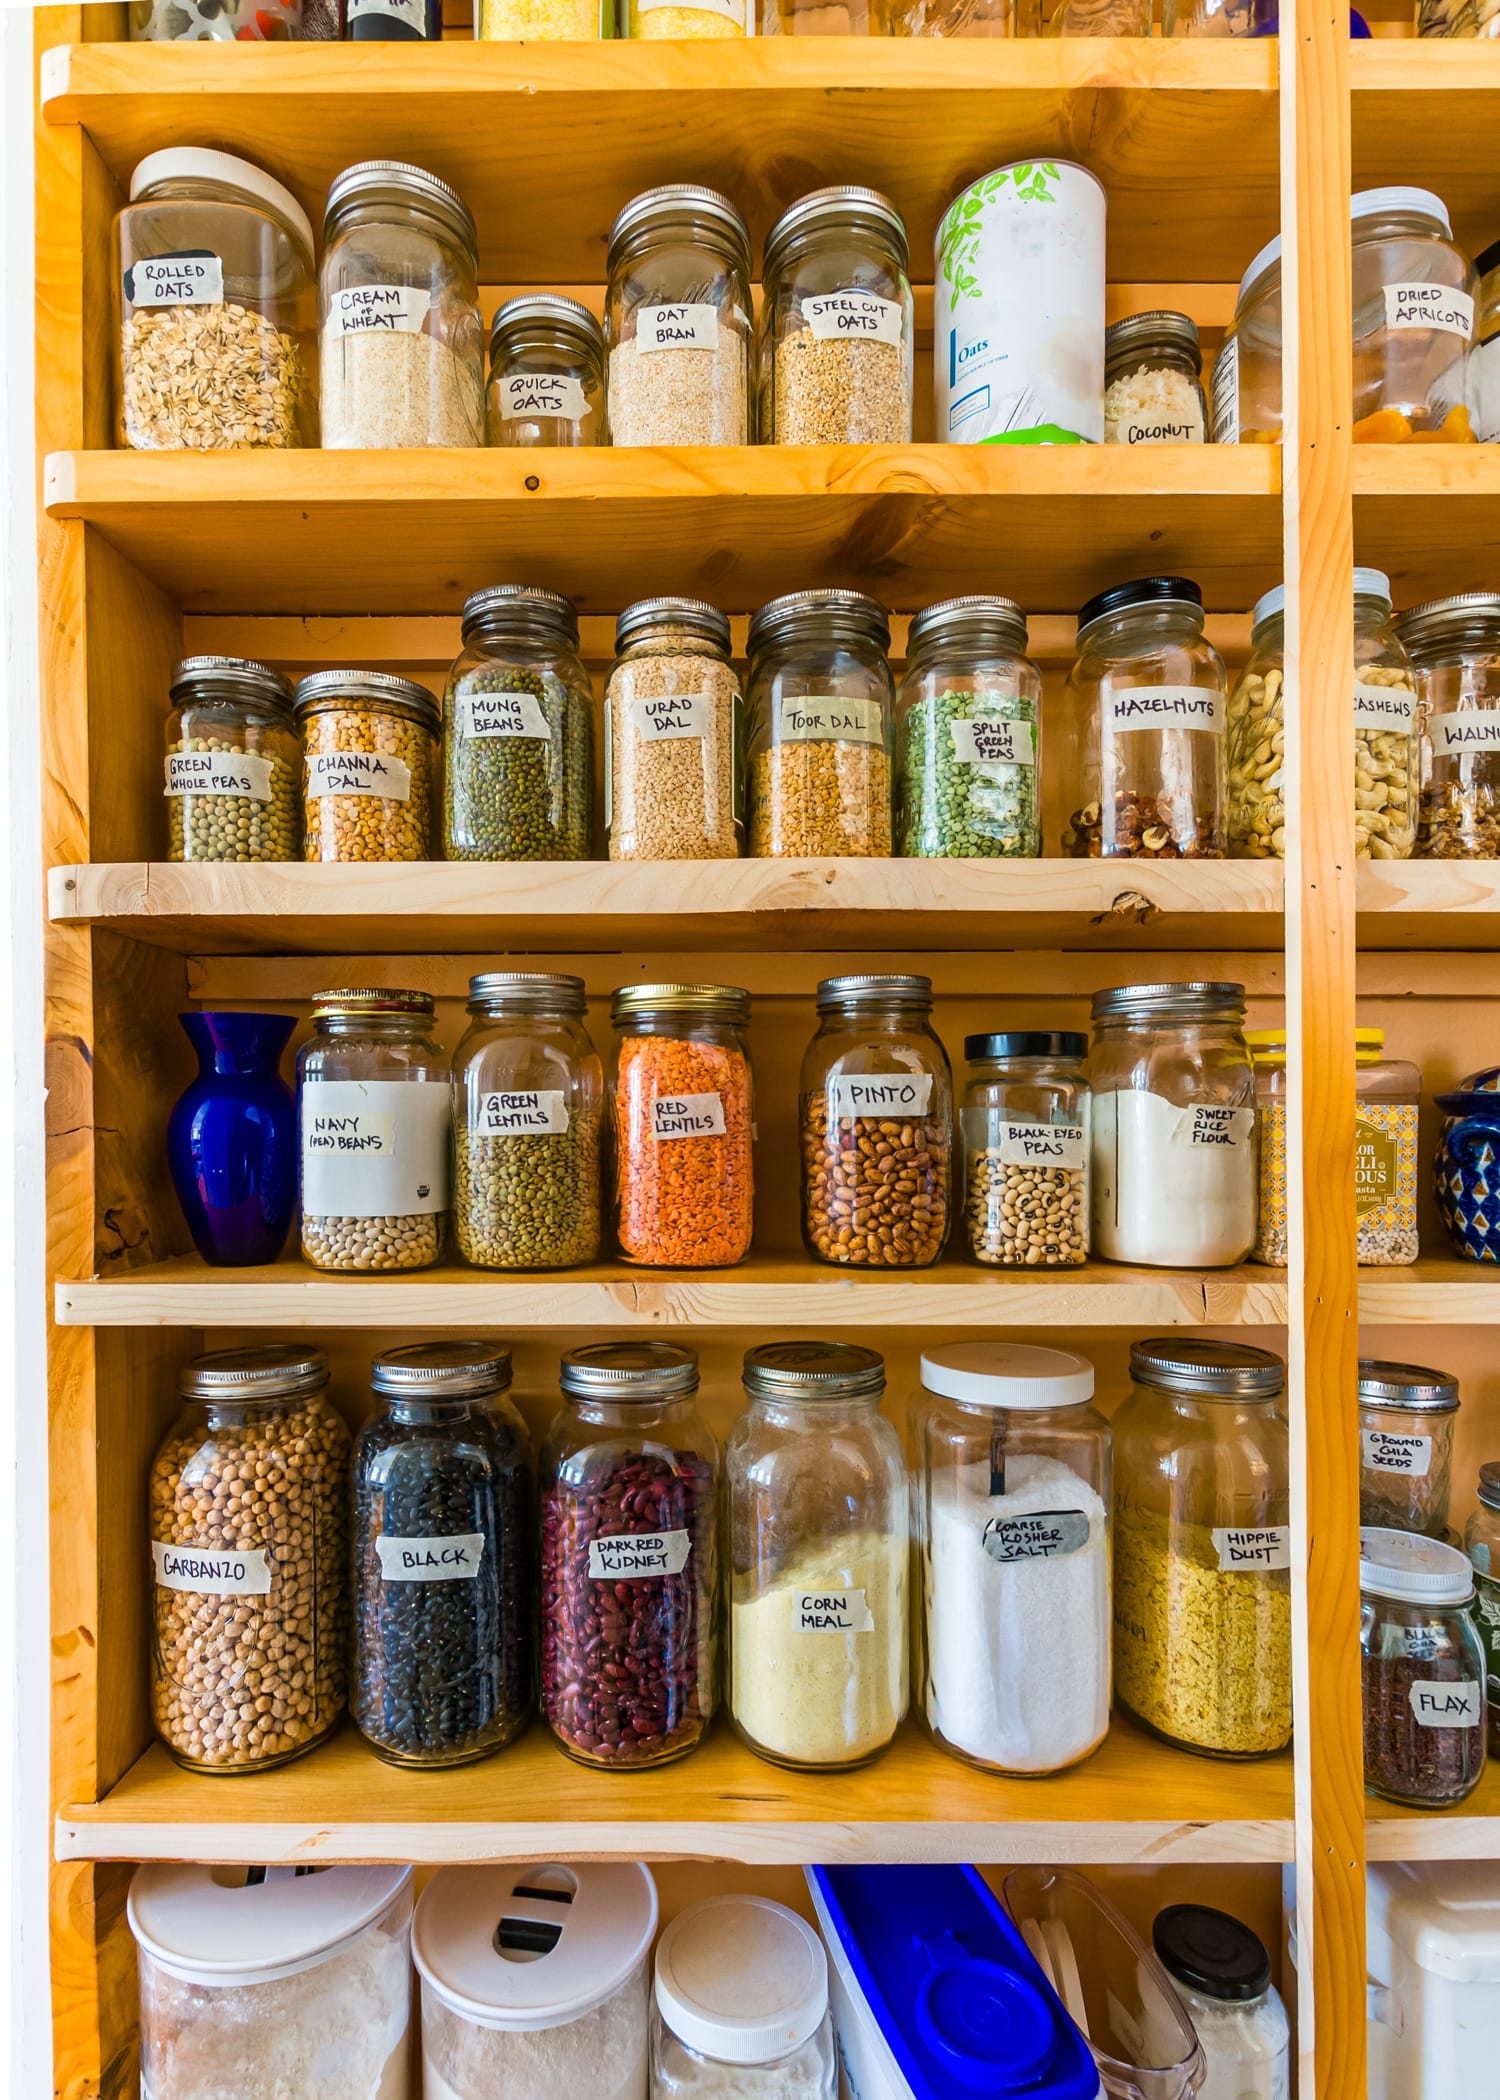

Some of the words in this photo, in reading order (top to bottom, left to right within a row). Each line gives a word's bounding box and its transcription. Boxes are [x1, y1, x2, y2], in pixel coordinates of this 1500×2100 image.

[146, 265, 204, 280] ROLLED
[156, 282, 193, 298] OATS
[1398, 290, 1441, 302] DRIED
[339, 288, 400, 311] CREAM
[657, 309, 688, 322] OAT
[813, 300, 857, 317] STEEL
[860, 303, 887, 320] CUT
[343, 312, 408, 330] WHEAT
[838, 315, 877, 329] OATS
[1396, 307, 1468, 332] APRICOTS
[657, 328, 695, 342] BRAN
[958, 339, 989, 363] Oats
[510, 378, 567, 392] QUICK
[513, 394, 562, 410] OATS
[1129, 424, 1194, 443] COCONUT
[472, 700, 520, 714] MUNG
[646, 699, 692, 715] URAD
[1115, 698, 1214, 717] HAZELNUTS
[474, 718, 524, 732] BEANS
[654, 716, 691, 731] DAL
[787, 711, 826, 730] TOOR
[831, 715, 866, 729] DAL
[972, 723, 1010, 736] SPLIT
[974, 735, 1012, 749] GREEN
[979, 747, 1014, 759] PEAS
[170, 757, 211, 775] GREEN
[318, 757, 388, 775] CHANNA
[170, 779, 208, 790] WHOLE
[212, 776, 251, 790] PEAS
[328, 775, 371, 788] DAL
[851, 1085, 915, 1104] PINTO
[487, 1094, 538, 1112] GREEN
[656, 1102, 688, 1117] RED
[488, 1110, 549, 1127] LENTILS
[1197, 1109, 1236, 1120] SWEET
[316, 1117, 359, 1132] NAVY
[656, 1115, 714, 1132] LENTILS
[1195, 1121, 1227, 1131] RICE
[310, 1135, 334, 1148] (PEA)
[338, 1136, 382, 1150] BEANS
[1193, 1129, 1236, 1145] FLOUR
[1024, 1142, 1063, 1155] PEAS
[1356, 1145, 1375, 1155] OR
[1355, 1170, 1387, 1183] OUS
[1370, 1434, 1423, 1448] GROUND
[1379, 1444, 1413, 1456] CHIA
[1372, 1453, 1412, 1467] SEEDS
[996, 1521, 1046, 1533] COARSE
[1000, 1528, 1063, 1546] KOSHER
[1228, 1533, 1280, 1545] HIPPIE
[598, 1541, 635, 1553] DARK
[634, 1539, 663, 1551] RED
[1001, 1544, 1056, 1558] SALT
[403, 1549, 469, 1567] BLACK
[600, 1550, 668, 1570] KIDNEY
[1229, 1547, 1279, 1563] DUST
[164, 1553, 245, 1580] GARBANZO
[802, 1597, 846, 1610] CORN
[802, 1615, 852, 1628] MEAL
[1420, 1694, 1471, 1715] FLAX
